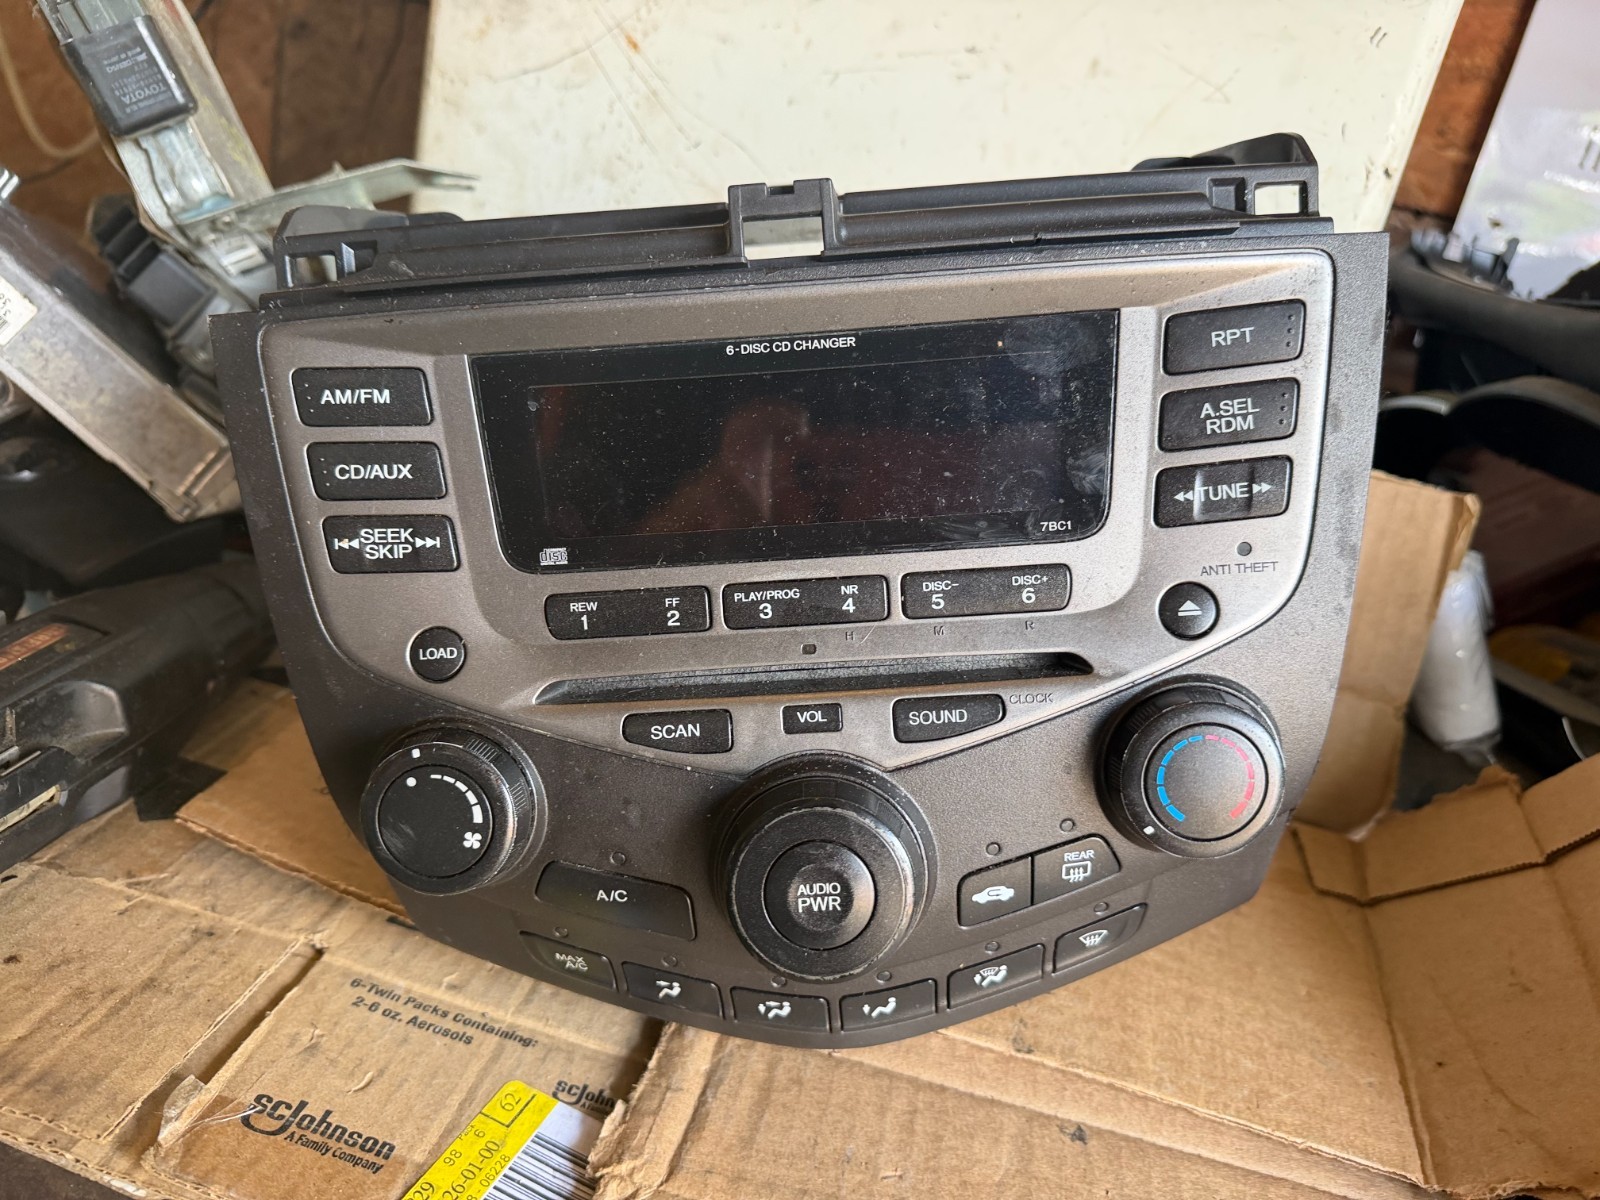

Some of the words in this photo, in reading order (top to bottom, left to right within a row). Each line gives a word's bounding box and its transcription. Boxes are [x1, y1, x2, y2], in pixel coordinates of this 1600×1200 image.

[120, 82, 167, 105] TOYOTA
[1211, 327, 1255, 347] RPT
[726, 342, 770, 356] 6-DISC
[772, 341, 791, 353] CD
[793, 337, 856, 351] CHANGER
[320, 389, 391, 405] AM/FM
[1200, 398, 1260, 419] A.SEL
[1206, 415, 1255, 435] RDM
[335, 463, 413, 480] CD/AUX
[1198, 482, 1249, 501] TUNE
[1040, 520, 1072, 533] 7BC1
[360, 528, 414, 544] SEEK
[365, 544, 413, 560] SKIP
[1200, 562, 1232, 577] ANTI
[1234, 561, 1279, 575] THEFT
[734, 588, 800, 603] PLAY/PROG
[841, 585, 859, 595] NR
[1021, 587, 1036, 604] 6
[570, 601, 598, 612] REW
[665, 597, 680, 608] FF
[842, 597, 856, 613] 4
[931, 594, 945, 610] 5
[667, 610, 681, 627] 2
[758, 603, 773, 619] 3
[580, 614, 589, 630] 1
[1025, 621, 1034, 630] R
[845, 631, 854, 641] H
[933, 626, 944, 636] M
[419, 647, 457, 660] LOAD
[1009, 693, 1053, 705] CLOCK
[796, 711, 828, 724] VOL
[909, 709, 968, 725] SOUND
[650, 723, 700, 740] SCAN
[1063, 849, 1095, 862] REAR
[596, 889, 628, 903] A/C
[796, 882, 841, 897] AUDIO
[797, 897, 841, 912] PWR
[555, 952, 586, 964] MAX
[565, 960, 588, 970] A/C
[350, 978, 401, 1003] 6-Twin
[403, 996, 450, 1019] Packs
[452, 1012, 539, 1048] Containing:
[351, 996, 380, 1013] 2-6
[381, 1008, 403, 1023] oz.
[406, 1015, 475, 1045] Aerosols
[500, 1093, 522, 1112] 62
[474, 1129, 486, 1139] 6
[284, 1131, 296, 1143] A
[295, 1134, 332, 1156] Family
[332, 1147, 385, 1175] Company
[443, 1149, 463, 1167] 98
[480, 1154, 511, 1188] 06228
[407, 1181, 436, 1200] 29
